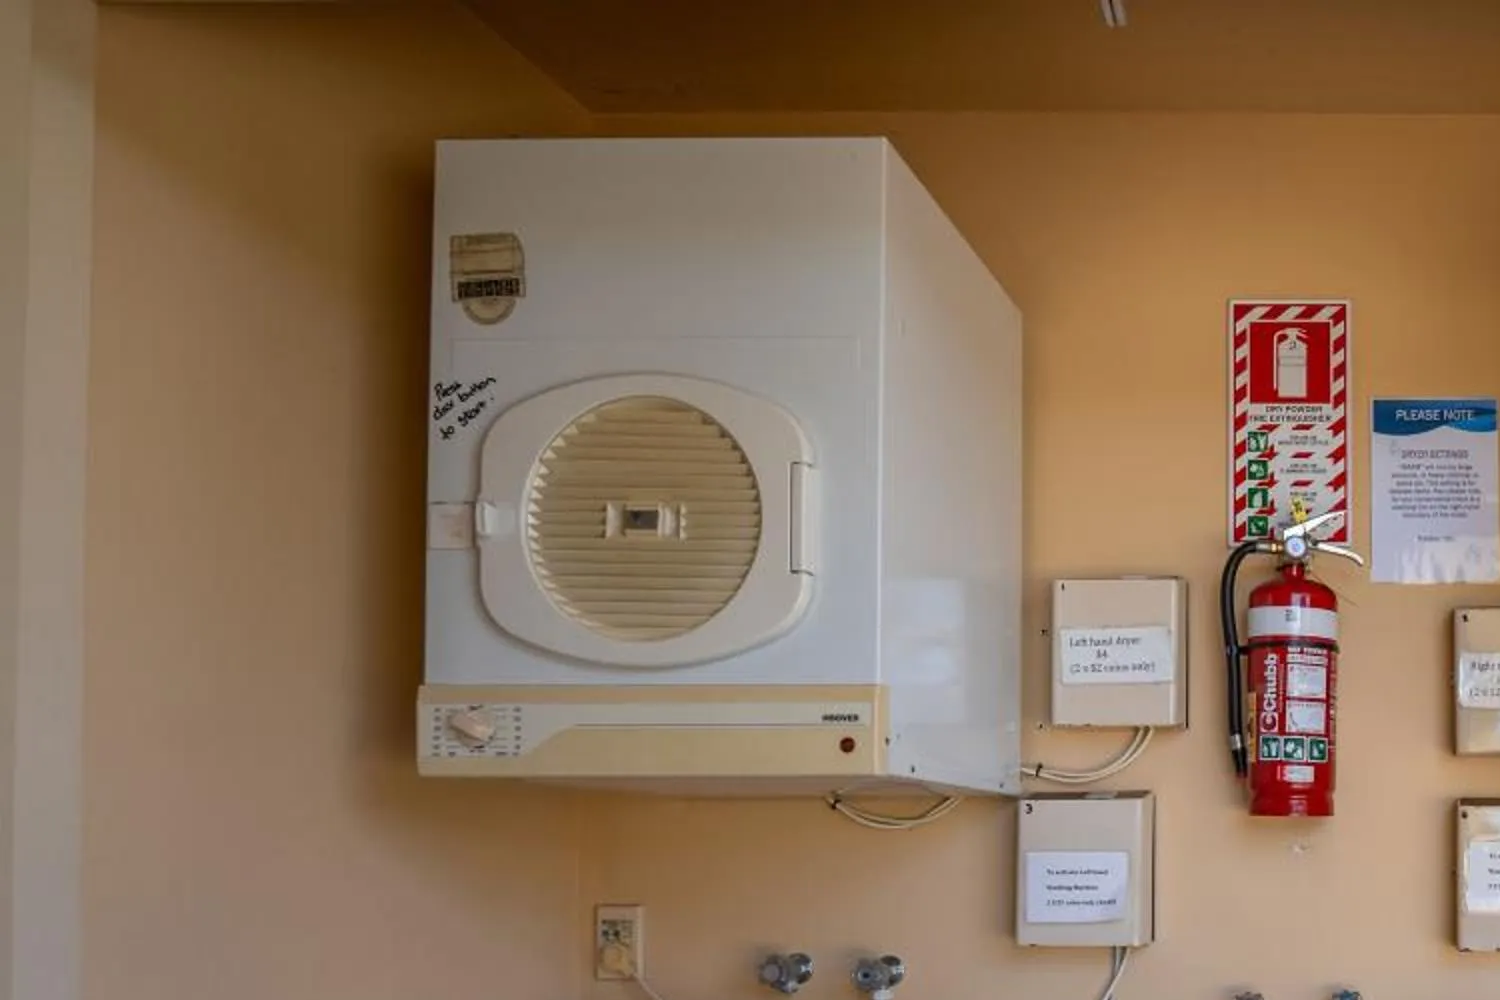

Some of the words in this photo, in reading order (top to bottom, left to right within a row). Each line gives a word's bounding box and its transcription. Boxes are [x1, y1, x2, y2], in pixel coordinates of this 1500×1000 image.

[1395, 409, 1440, 421] PLEASE
[1443, 409, 1475, 421] NOTE
[1263, 653, 1277, 712] Chubb
[821, 713, 859, 722] HOOVER
